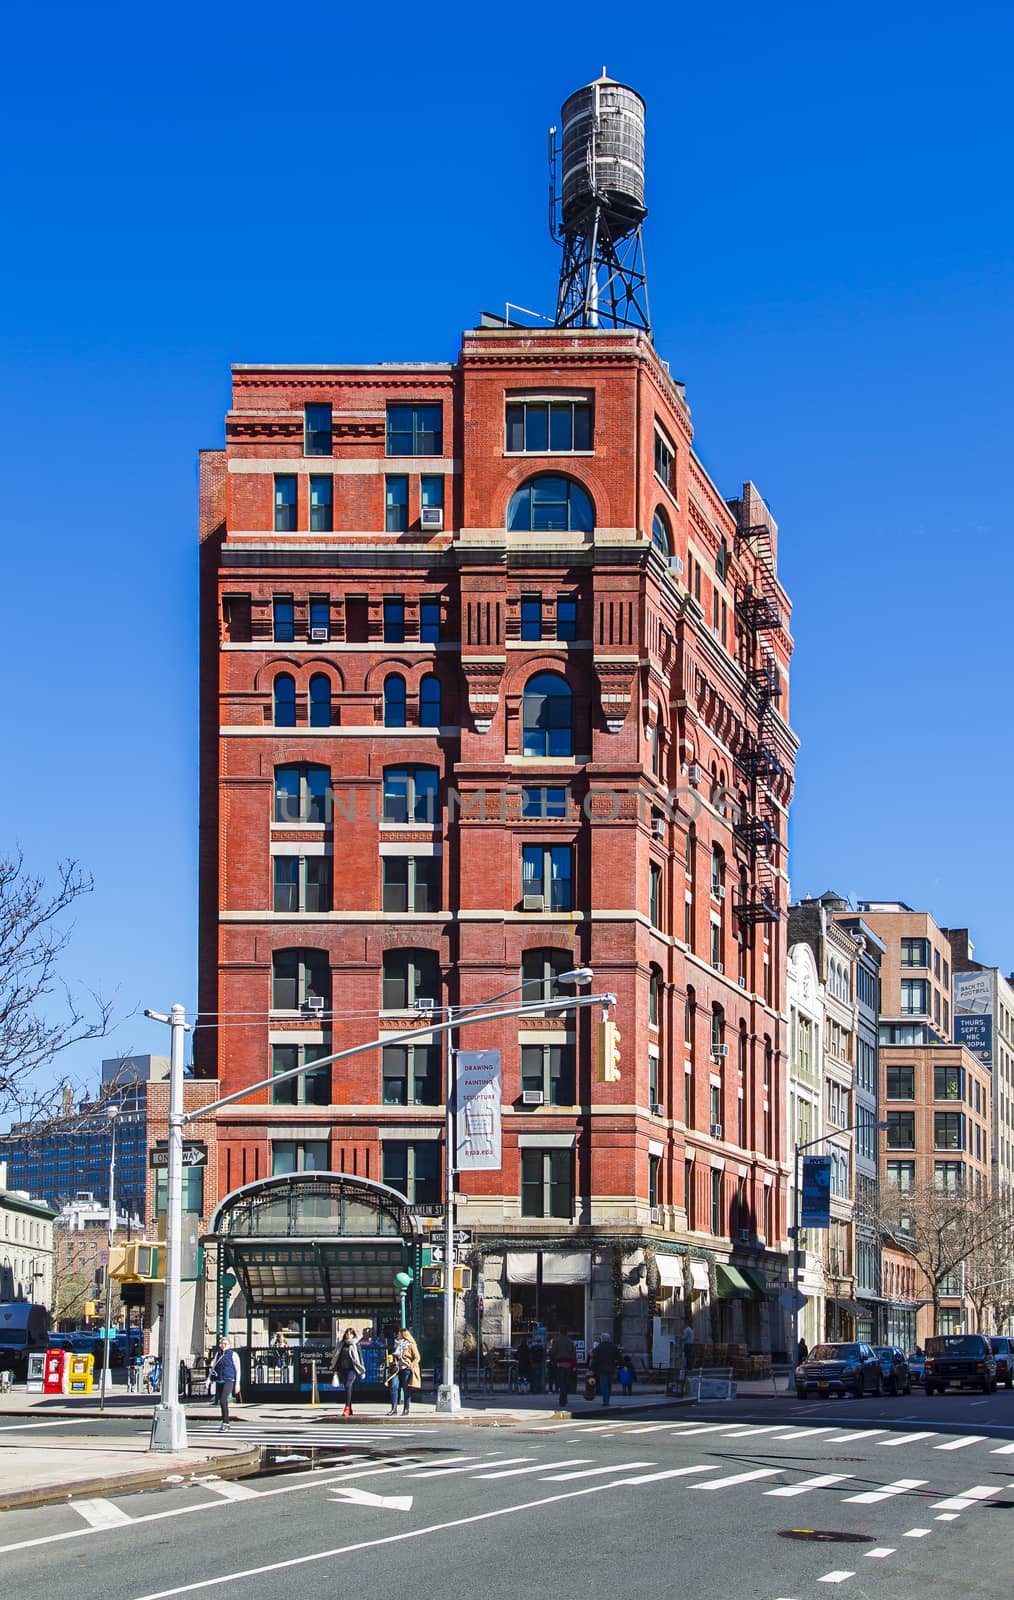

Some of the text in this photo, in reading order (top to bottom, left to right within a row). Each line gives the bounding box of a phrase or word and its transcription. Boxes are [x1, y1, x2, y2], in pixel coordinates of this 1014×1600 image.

[960, 984, 976, 992] BACK
[960, 988, 990, 998] FOOTBALL
[157, 1151, 199, 1162] ON WAY
[403, 1205, 442, 1215] FRANKLIN ST
